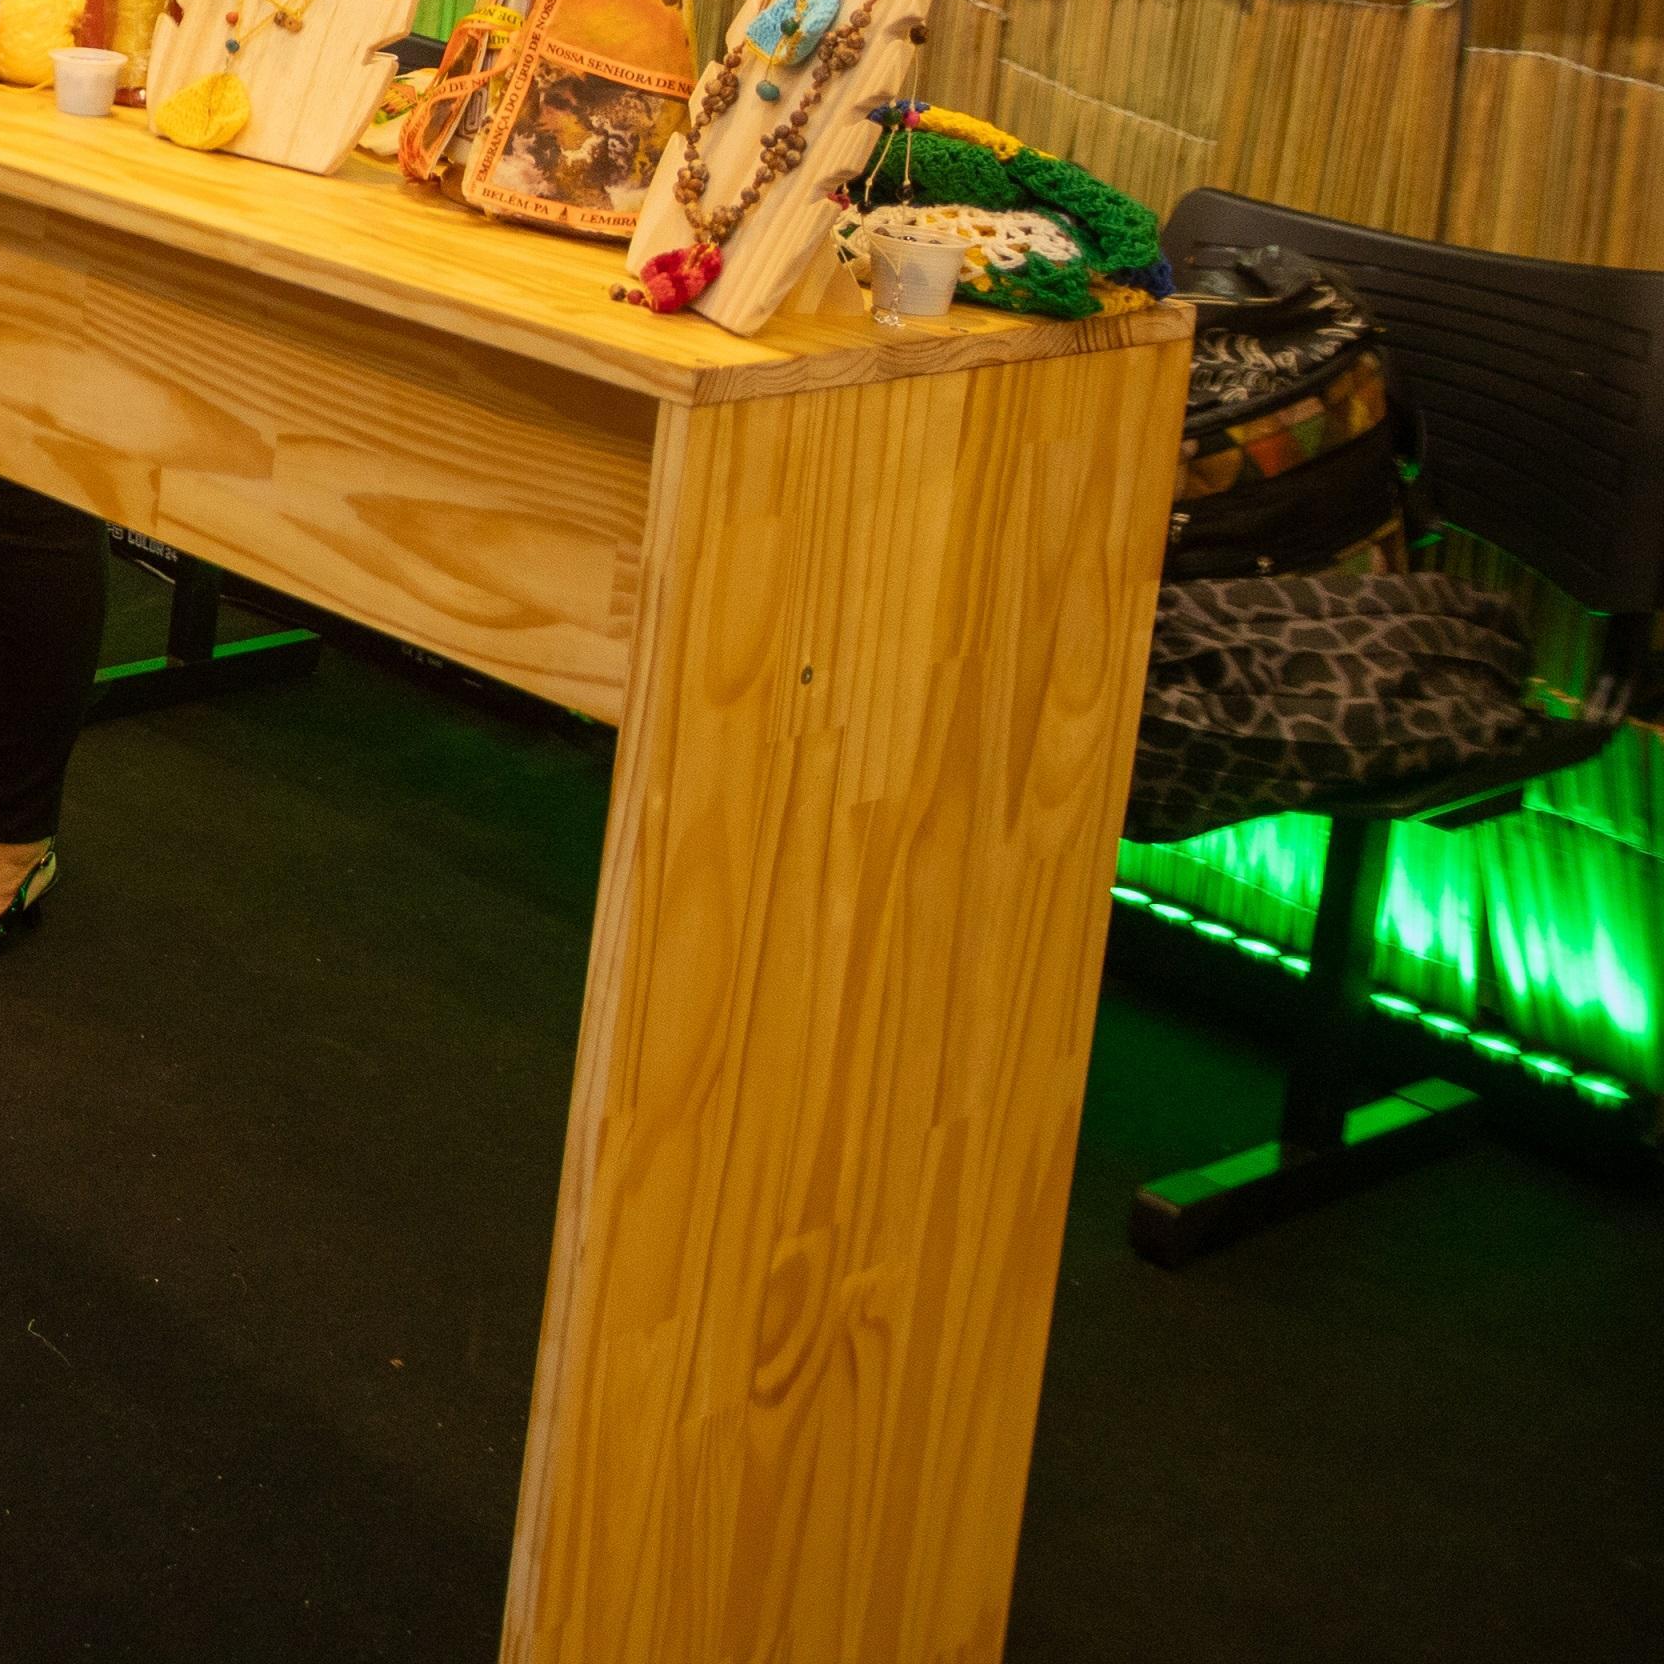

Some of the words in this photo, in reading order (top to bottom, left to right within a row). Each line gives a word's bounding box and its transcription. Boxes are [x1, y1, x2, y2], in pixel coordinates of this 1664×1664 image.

[504, 94, 519, 113] DO
[528, 31, 541, 51] DE
[546, 42, 585, 65] NOSSA
[587, 56, 653, 86] SENHORA
[655, 76, 674, 90] DE
